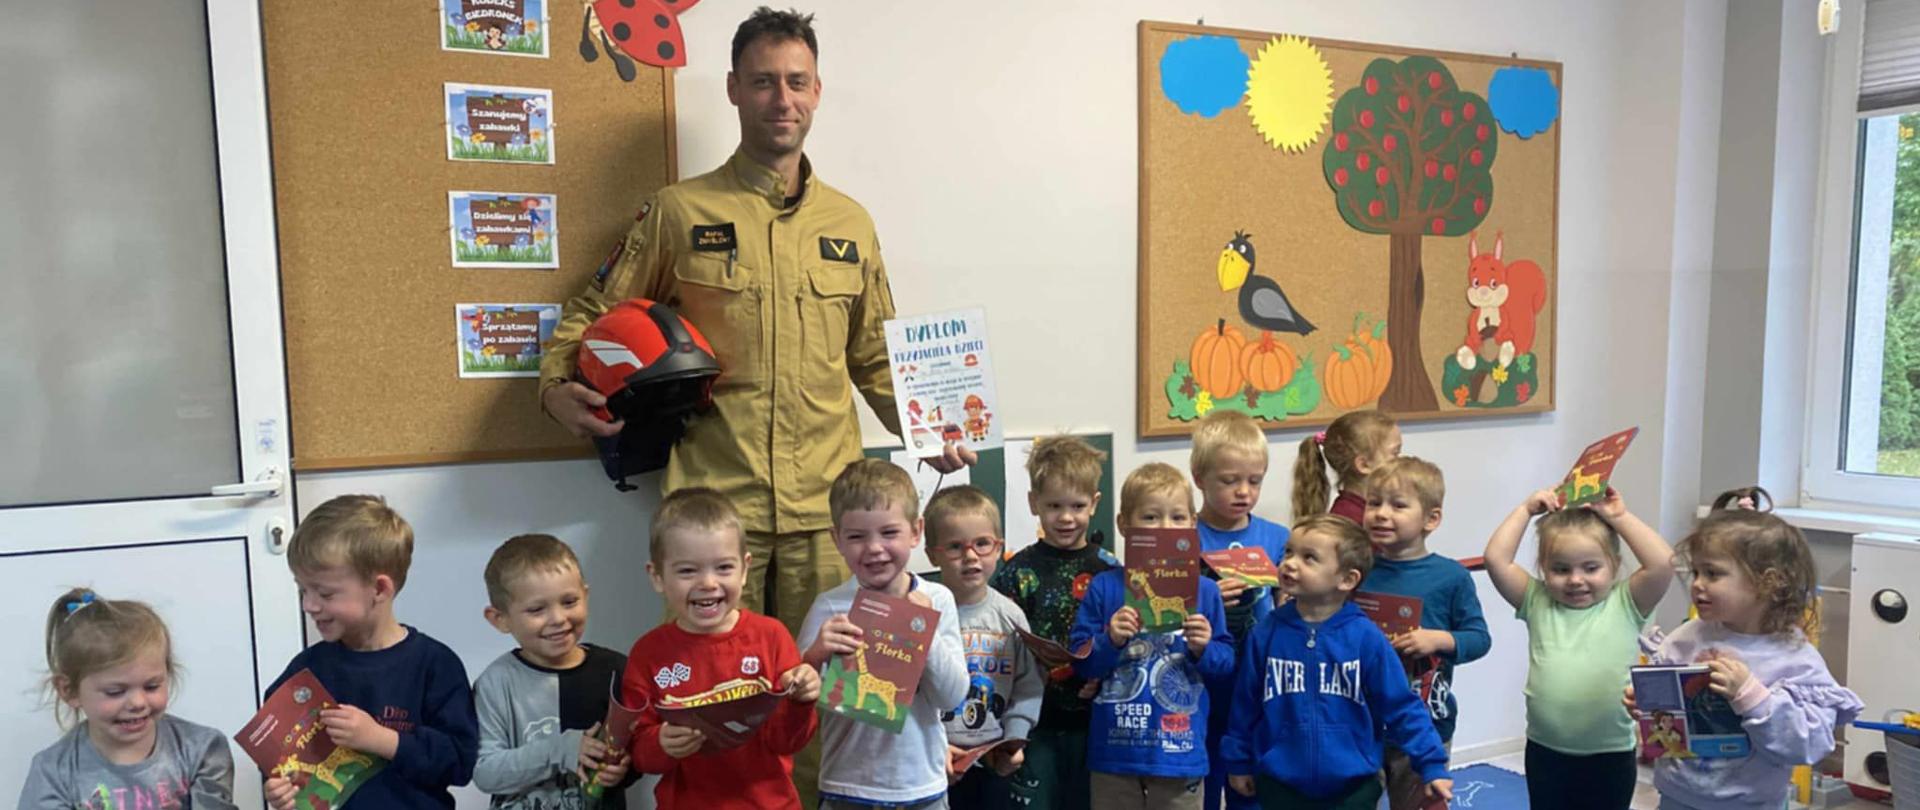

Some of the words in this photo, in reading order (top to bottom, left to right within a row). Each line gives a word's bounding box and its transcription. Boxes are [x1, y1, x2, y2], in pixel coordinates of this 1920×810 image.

[472, 108, 526, 121] Szanujemy
[479, 122, 520, 131] zabawki
[473, 211, 516, 222] Dzielimy
[476, 225, 531, 233] zabawkami
[482, 323, 537, 333] Sprzątamy
[905, 319, 967, 343] DYPLOM
[483, 336, 496, 345] po
[498, 335, 537, 344] zabawie
[874, 642, 912, 663] Florka
[1263, 657, 1306, 702] EVER
[1115, 703, 1152, 716] SPEED
[1117, 716, 1148, 728] RACE
[296, 721, 328, 750] Flork
